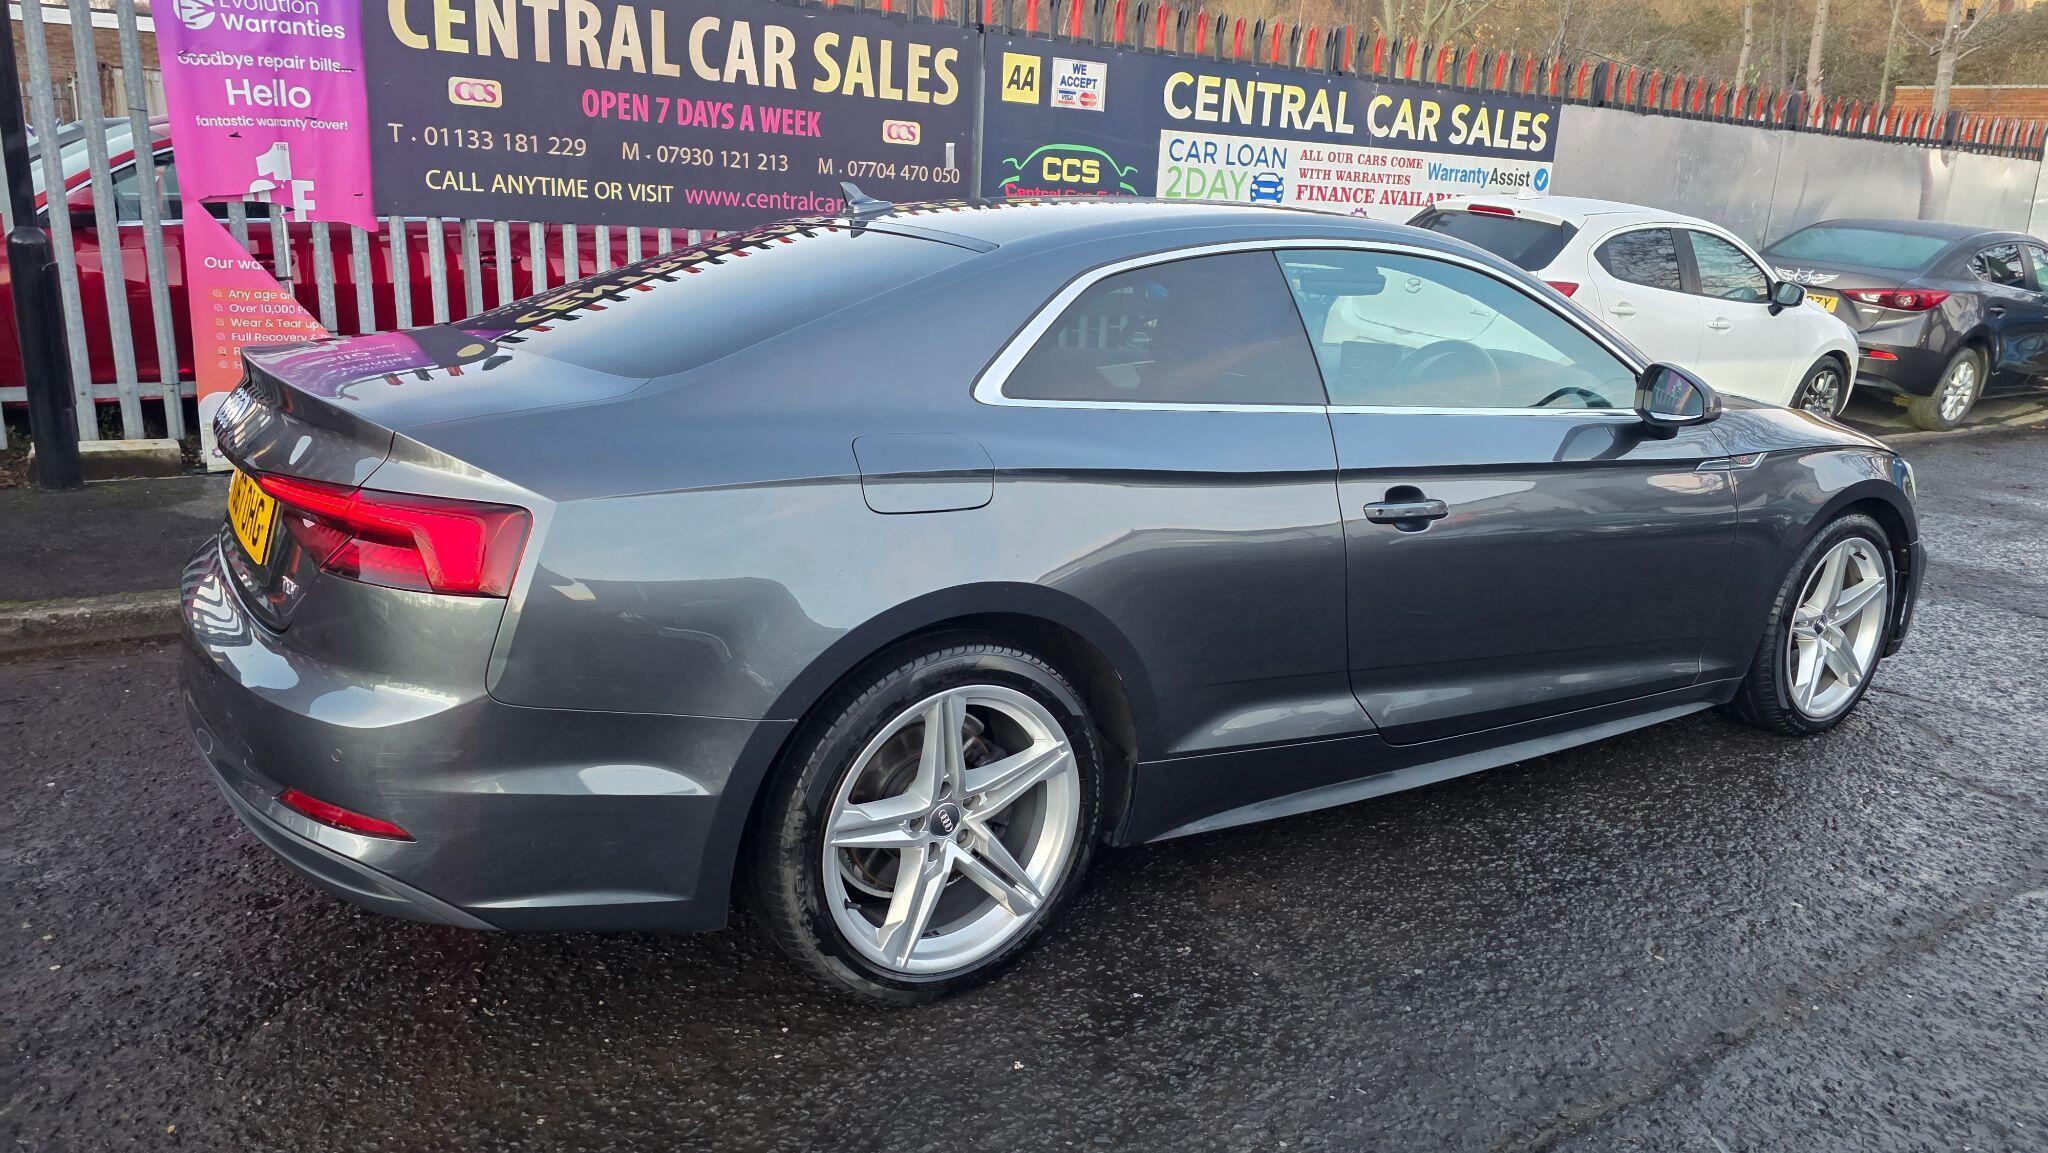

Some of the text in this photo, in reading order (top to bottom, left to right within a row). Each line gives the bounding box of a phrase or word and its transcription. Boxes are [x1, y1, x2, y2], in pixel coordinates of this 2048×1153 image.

[220, 13, 346, 39] Warranties
[177, 51, 254, 70] Goodbye
[258, 55, 306, 71] repair
[388, 0, 959, 105] CENTRAL CAR SALES
[1007, 65, 1035, 92] AA
[1072, 63, 1088, 75] WE
[454, 81, 497, 103] CCS
[1060, 75, 1098, 89] ACCEPT
[225, 79, 312, 108] Hello
[582, 88, 821, 137] OPEN 7 DAYS A WEEK
[1164, 71, 1549, 152] CENTRAL CAR SALES
[196, 115, 348, 131] fantastic warranty cover!
[886, 124, 917, 142] CCS
[424, 126, 494, 150] 01133
[503, 133, 538, 153] 181
[547, 136, 587, 157] 229
[656, 145, 714, 166] 07930
[720, 150, 749, 169] 121
[757, 153, 789, 172] 213
[1169, 138, 1288, 169] CAR LOAN
[1300, 149, 1424, 169] ALL OUR CARS COME
[847, 160, 896, 179] 07704
[900, 165, 928, 182] 470
[933, 167, 960, 184] 050
[1042, 157, 1100, 184] CCS
[1299, 168, 1411, 185] WITH WARRANTIES
[425, 169, 484, 193] CALL
[491, 173, 588, 199] ANYTIME
[594, 182, 622, 200] OR
[628, 183, 674, 203] VISIT
[1165, 165, 1248, 200] 2DAY
[1294, 184, 1375, 203] FINANCE
[204, 256, 234, 269] Our
[228, 289, 251, 301] Any
[254, 291, 278, 301] age
[230, 304, 257, 313] Over
[260, 304, 296, 314] 10,000
[230, 318, 319, 331] Wear & Tear up
[231, 332, 252, 341] Full
[254, 333, 308, 342] Recovery
